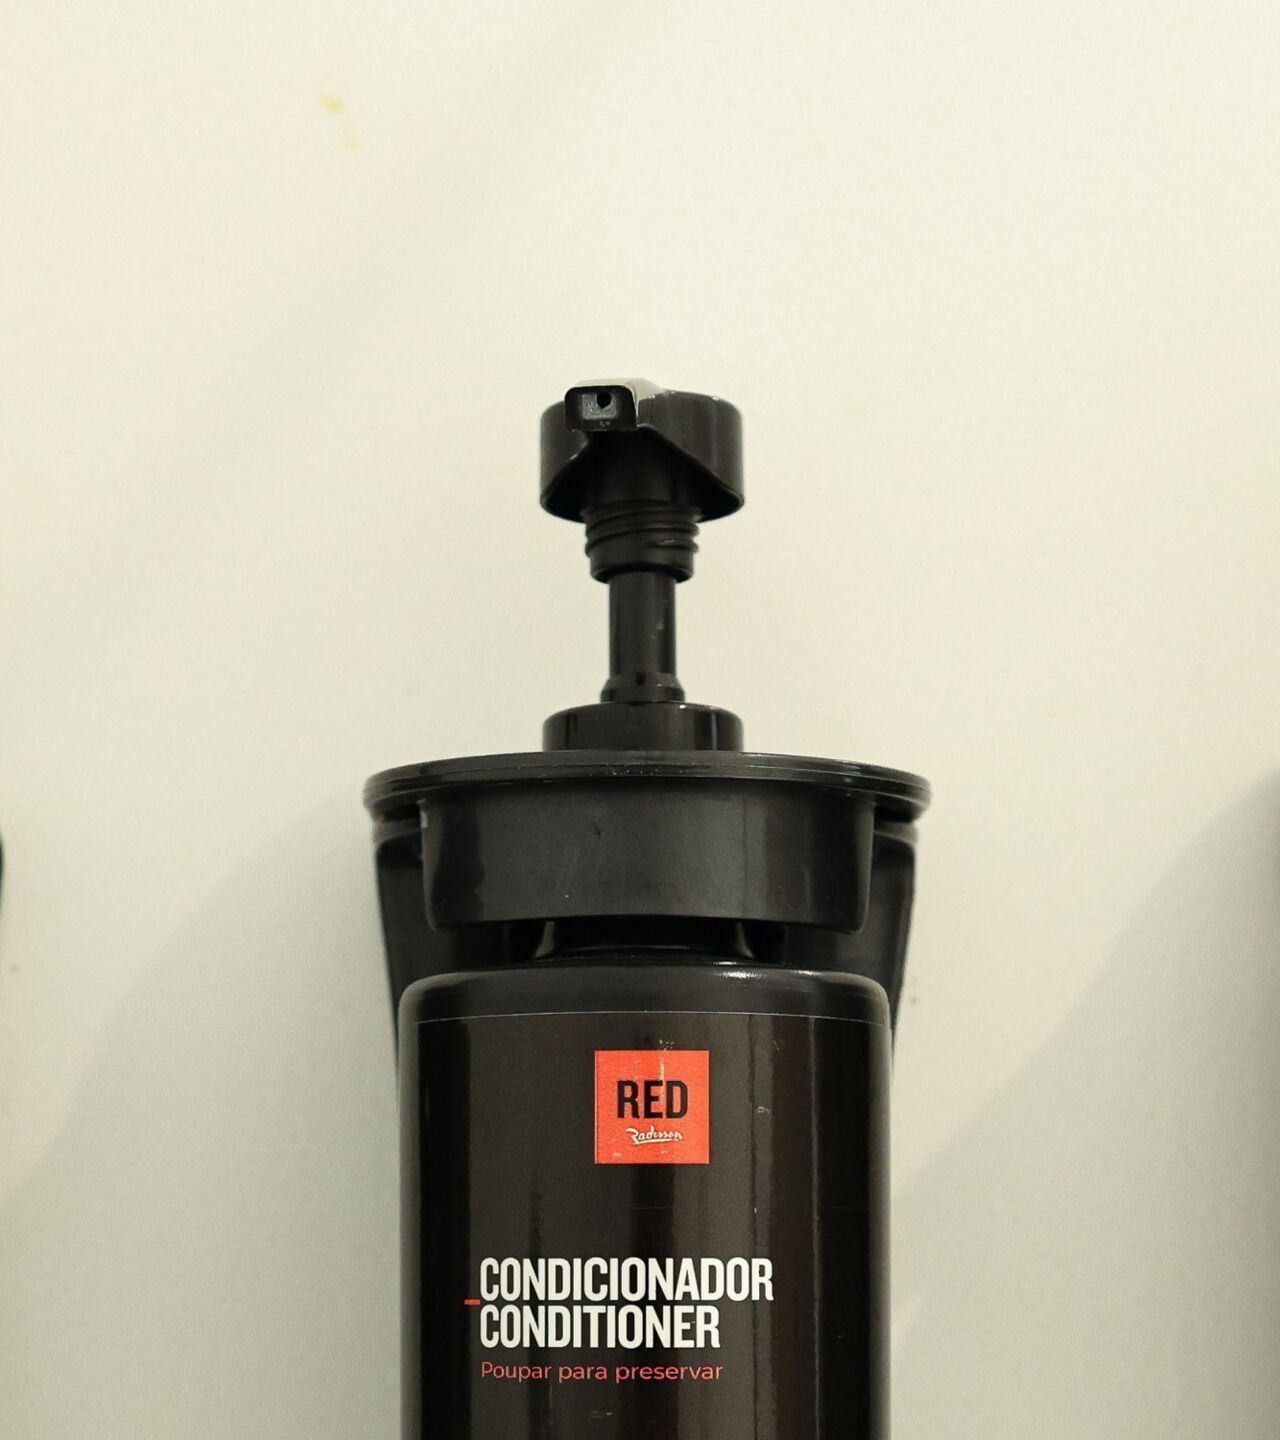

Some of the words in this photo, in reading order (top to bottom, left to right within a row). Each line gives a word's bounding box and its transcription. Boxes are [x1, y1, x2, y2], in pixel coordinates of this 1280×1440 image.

[617, 1080, 688, 1119] RED
[480, 1257, 774, 1301] CONDICIONADOR
[480, 1304, 721, 1349] CONDITIONER
[480, 1361, 552, 1382] Poupar
[558, 1365, 608, 1382] para
[615, 1364, 724, 1383] preservar
